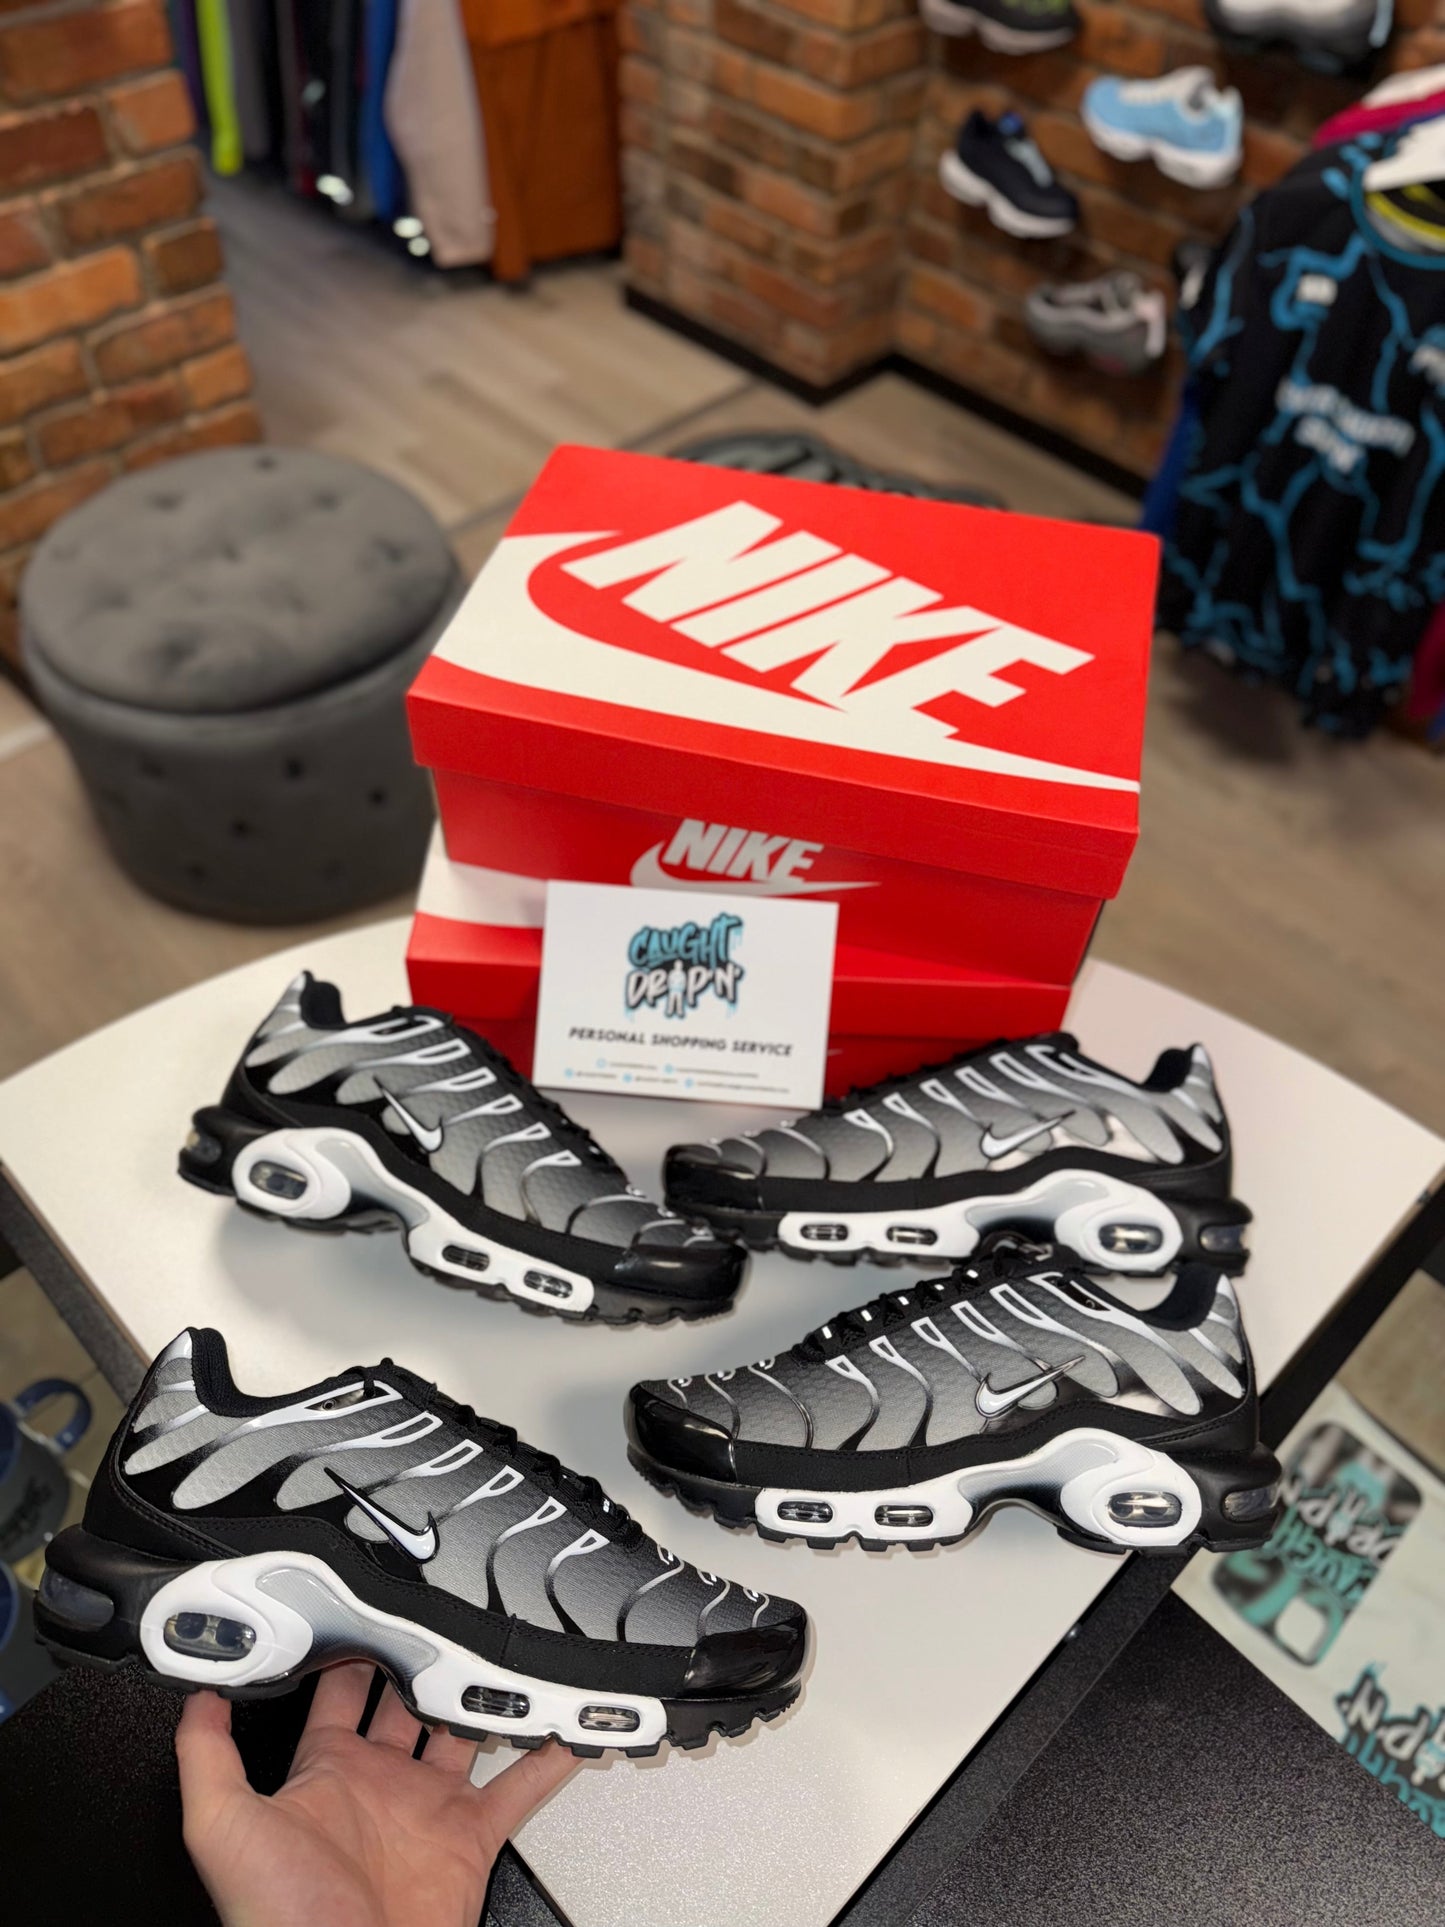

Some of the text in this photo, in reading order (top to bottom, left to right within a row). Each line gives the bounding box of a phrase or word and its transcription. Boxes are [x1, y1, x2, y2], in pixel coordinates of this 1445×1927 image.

[560, 501, 1094, 738] NIKE
[662, 818, 824, 884] NIKE
[628, 912, 743, 968] CAUGHT
[569, 1027, 793, 1057] PERSONAL SHOPPING SERVICE
